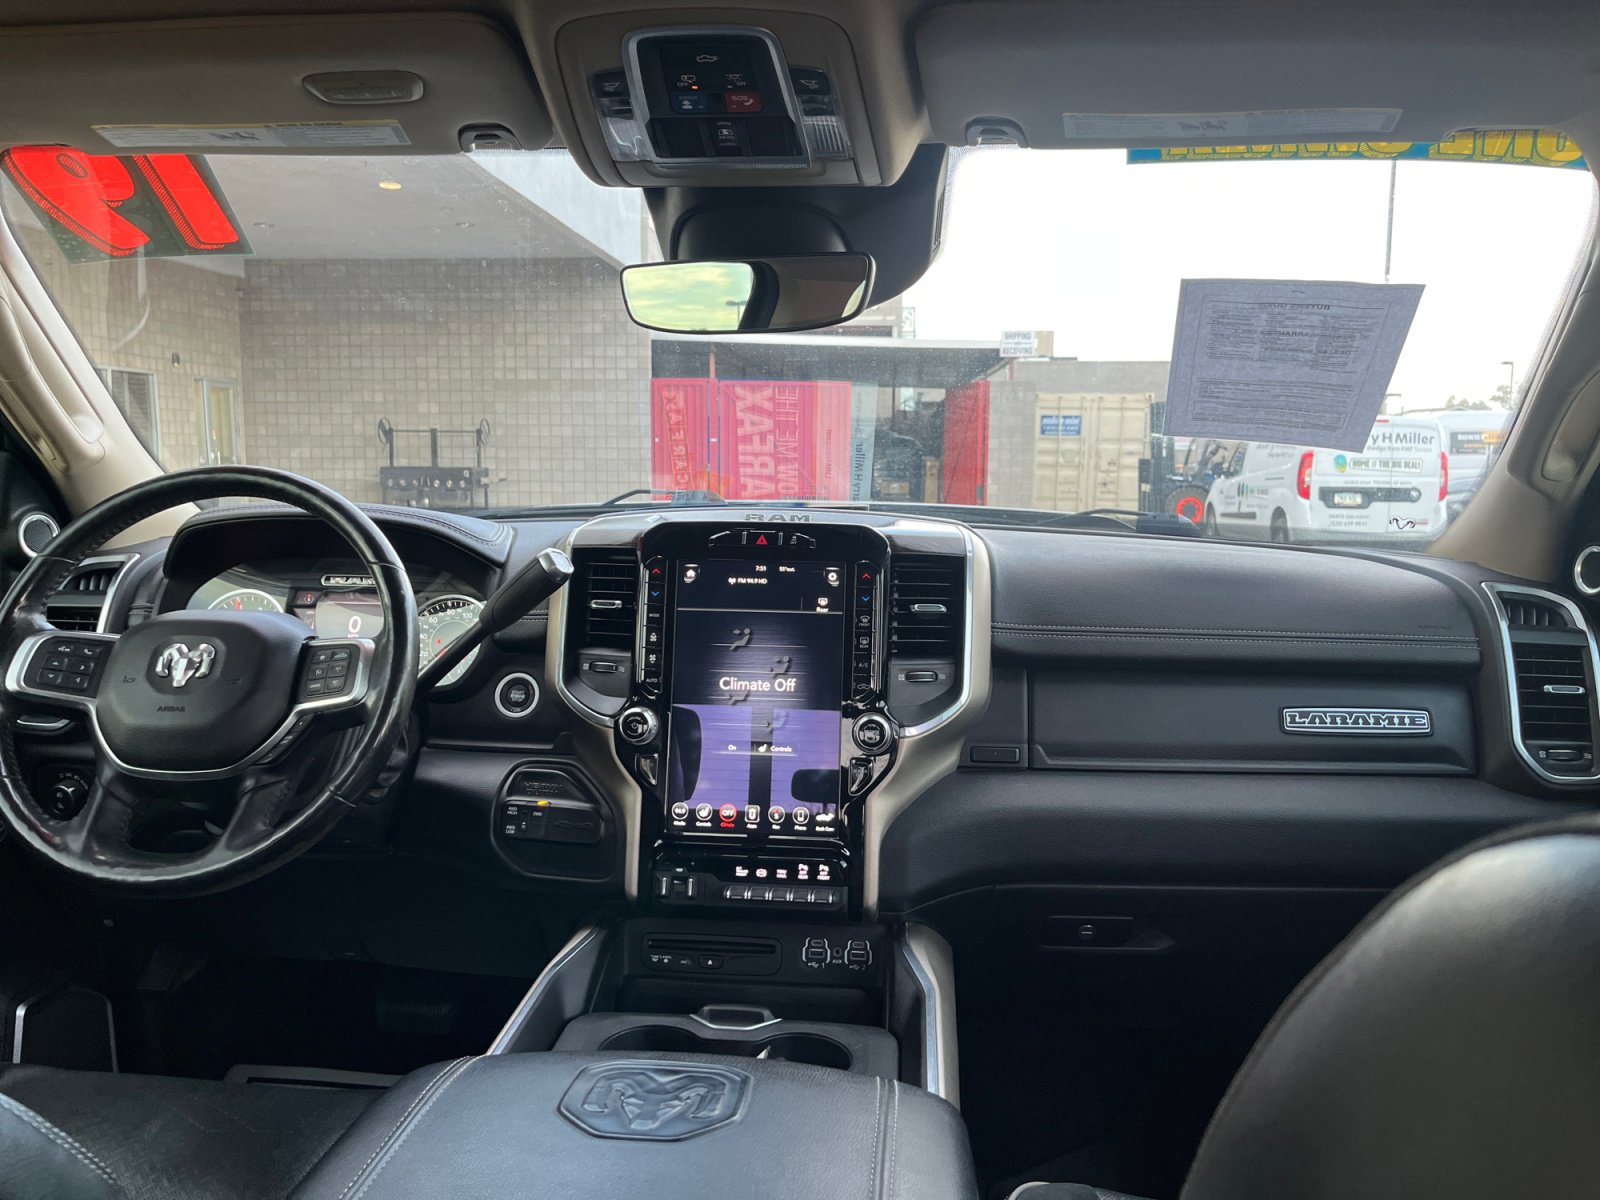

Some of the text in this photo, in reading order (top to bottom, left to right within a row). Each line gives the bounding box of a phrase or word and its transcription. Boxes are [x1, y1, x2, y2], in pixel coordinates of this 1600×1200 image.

[1382, 432, 1392, 443] H
[1395, 432, 1435, 445] Miller
[745, 514, 810, 522] RAM
[348, 616, 362, 633] 0
[719, 677, 797, 692] Climate Off
[1287, 712, 1428, 727] LARAMIE
